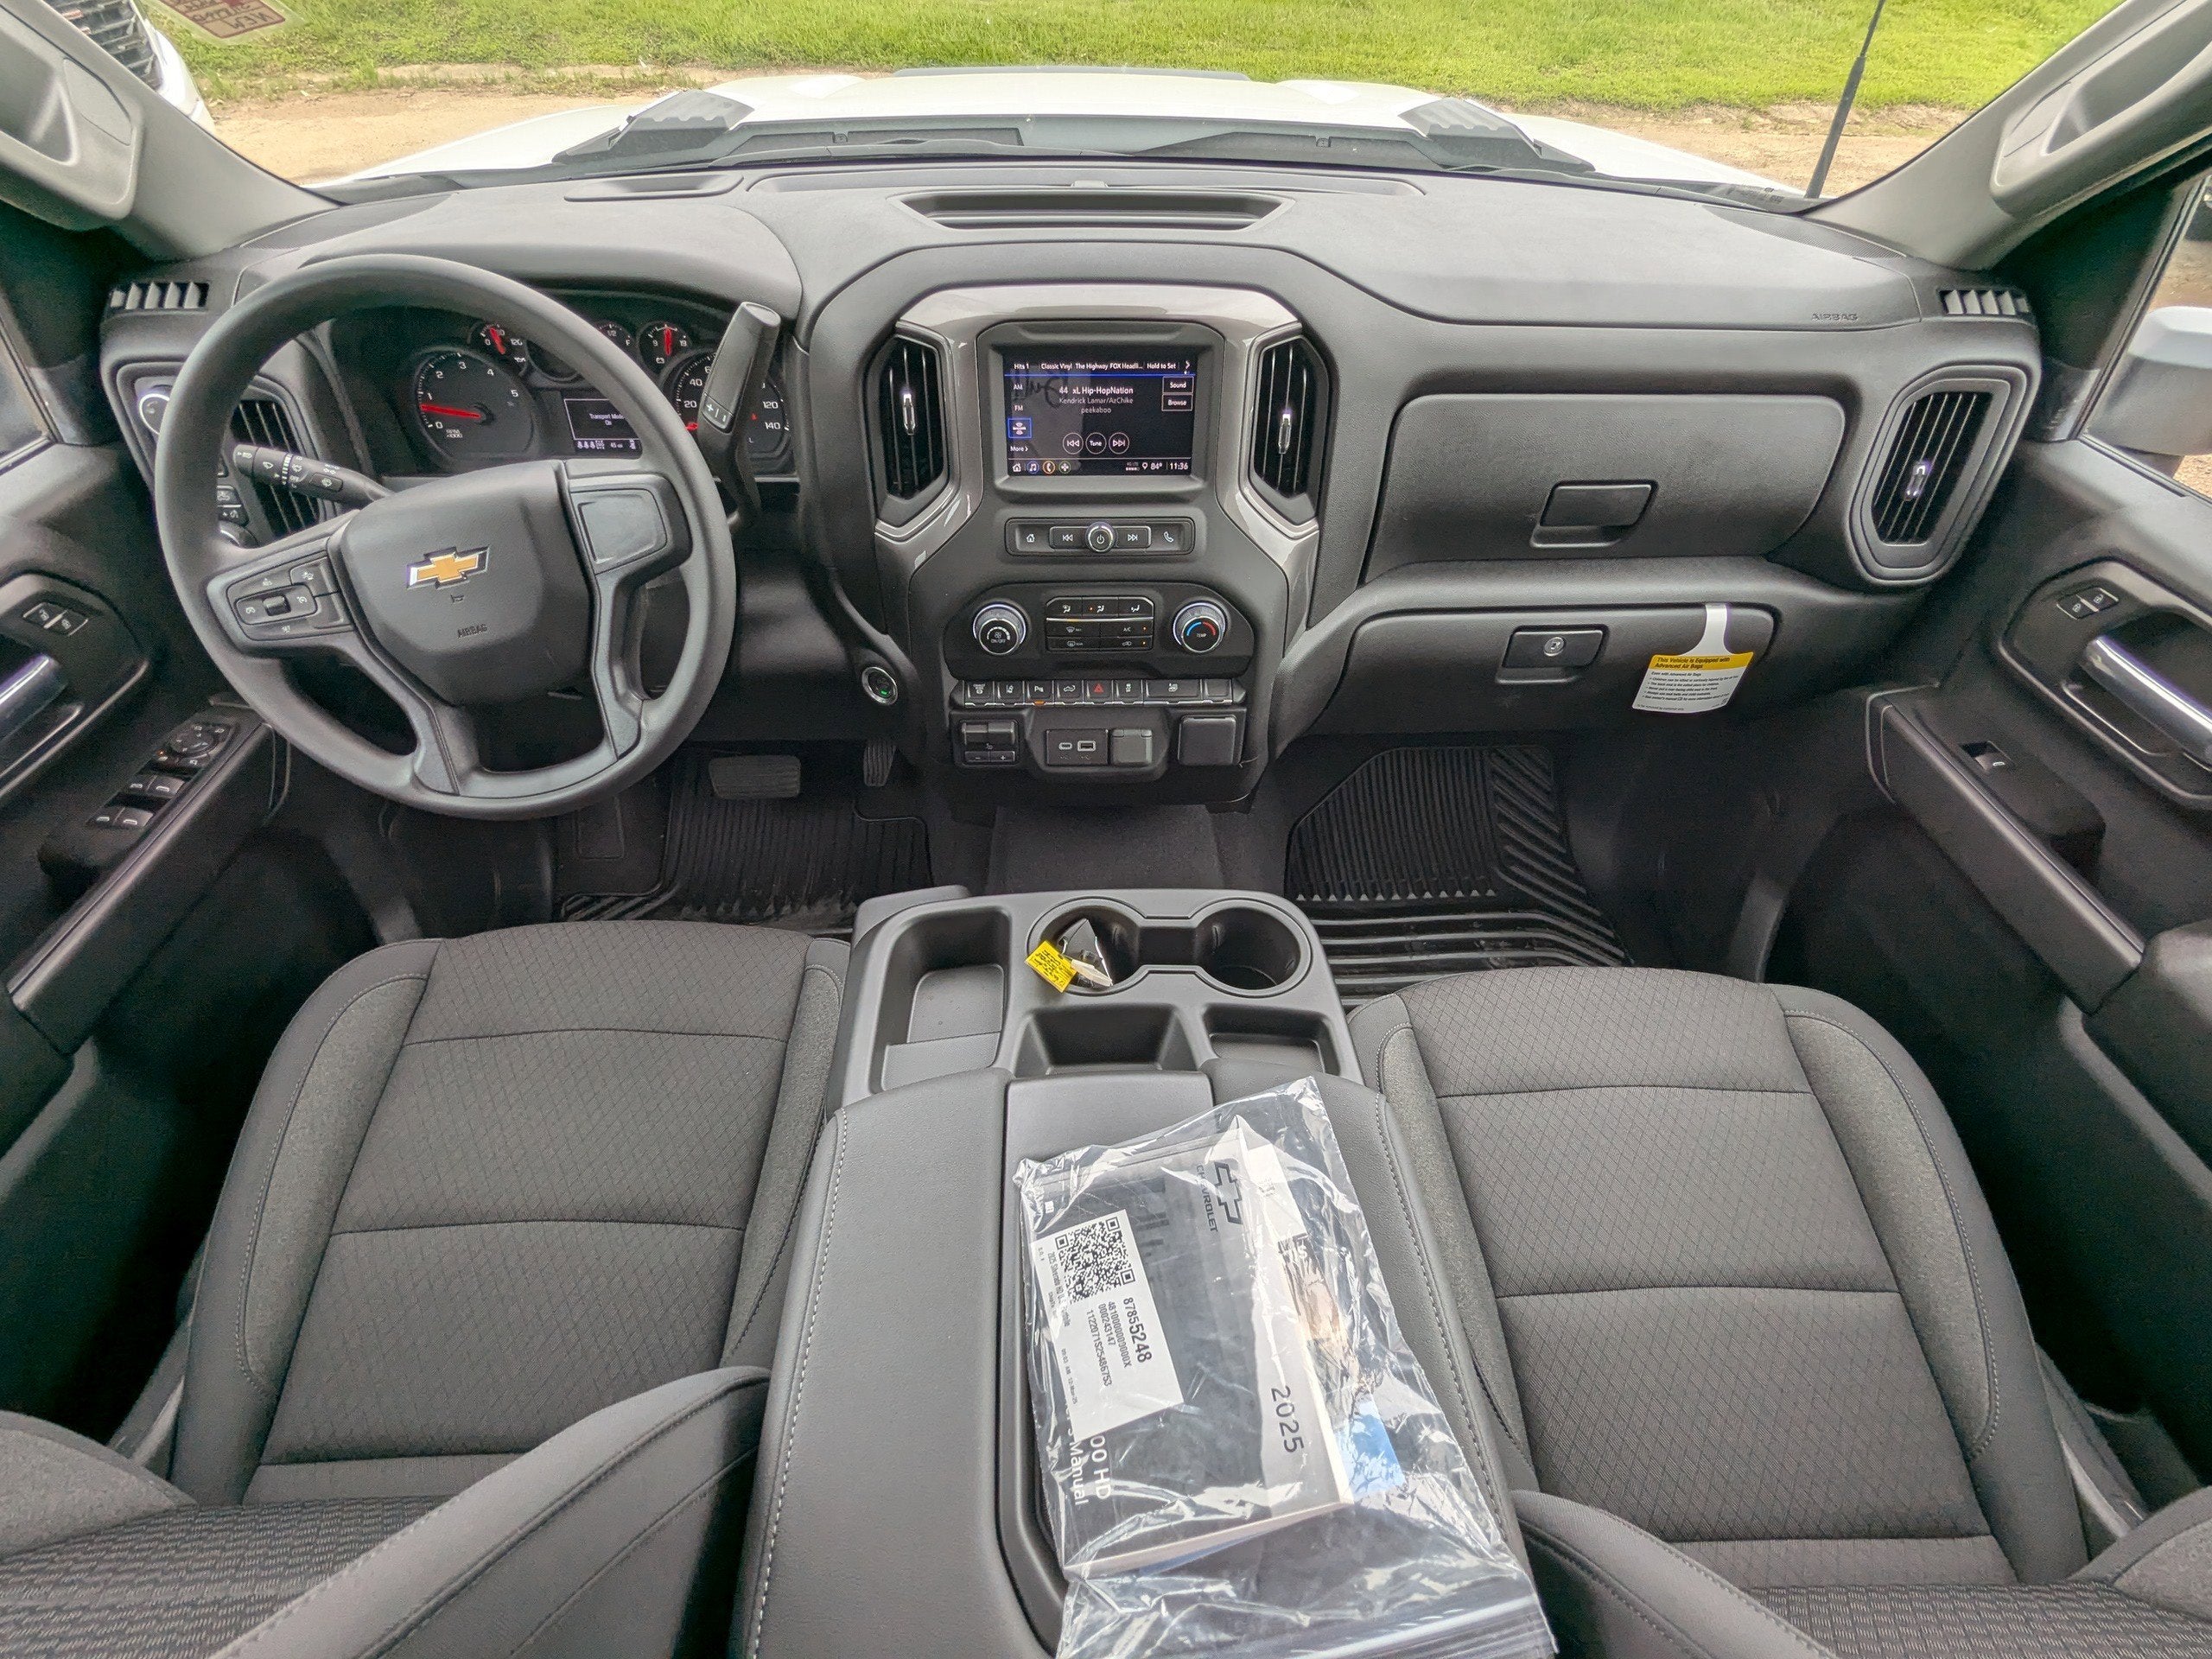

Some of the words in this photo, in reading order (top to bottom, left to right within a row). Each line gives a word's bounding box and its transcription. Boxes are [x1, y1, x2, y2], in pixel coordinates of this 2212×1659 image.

[1082, 386, 1134, 396] Hip-HopNation
[456, 624, 487, 639] AIRBAG
[1098, 1304, 1116, 1344] 000243147
[1122, 1297, 1152, 1363] 87855248
[1086, 1310, 1112, 1386] 1122071S25486753
[1271, 1385, 1304, 1453] 2025
[1090, 1435, 1108, 1463] 00
[1069, 1441, 1089, 1505] Manual
[1093, 1468, 1111, 1500] HD
